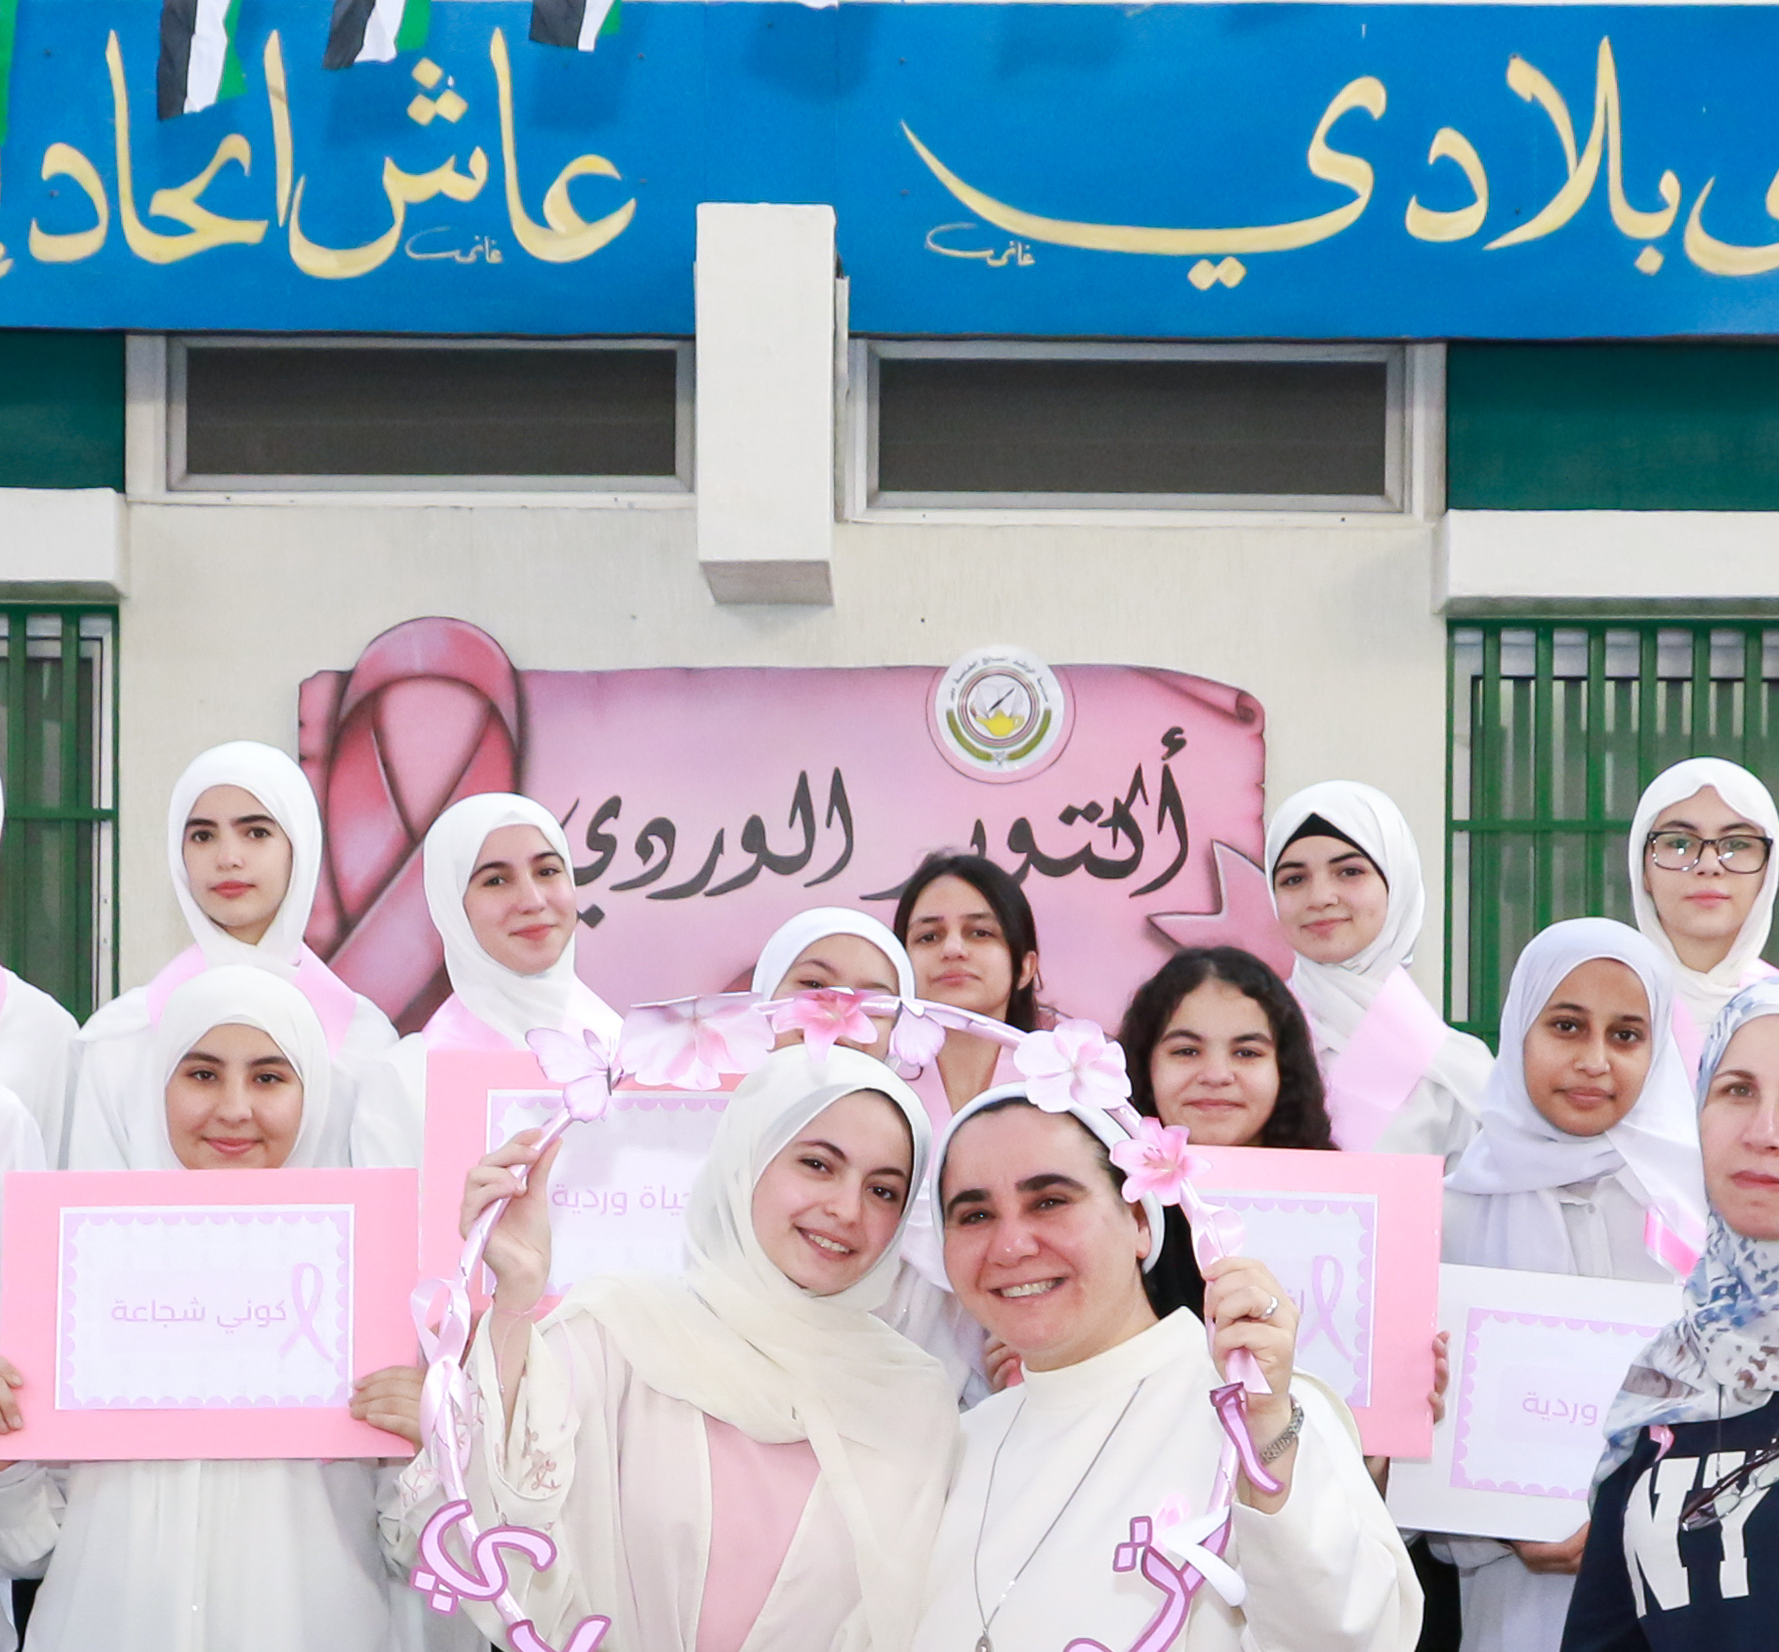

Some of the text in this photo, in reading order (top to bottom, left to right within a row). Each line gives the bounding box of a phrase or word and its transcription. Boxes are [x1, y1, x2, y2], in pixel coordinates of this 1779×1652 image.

[288, 26, 638, 281] عاش
[900, 35, 1682, 291] بلادي
[560, 726, 1188, 929] أكتور الوردي
[551, 1183, 691, 1217] ياة وردية
[111, 1296, 287, 1335] كوني شجاعة
[1521, 1391, 1599, 1426] وردية
